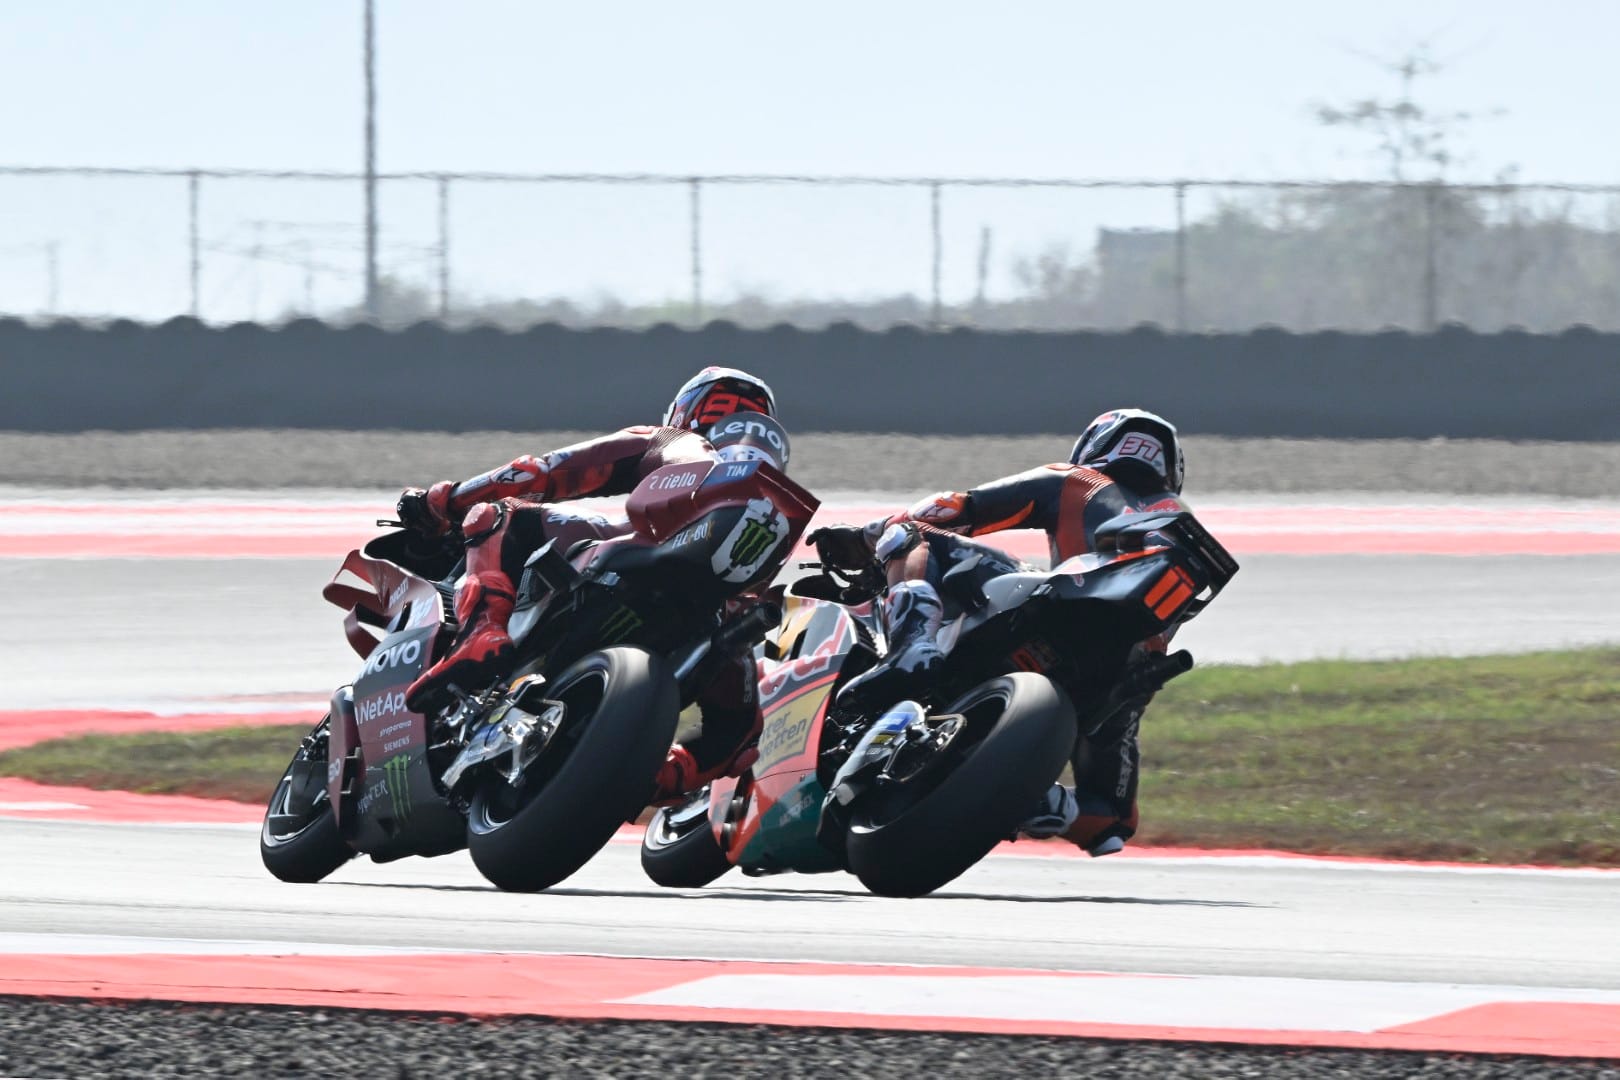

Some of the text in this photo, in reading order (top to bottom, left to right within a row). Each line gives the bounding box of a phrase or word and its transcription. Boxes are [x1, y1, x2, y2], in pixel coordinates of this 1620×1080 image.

[1118, 436, 1161, 461] 37
[725, 465, 749, 477] TIM
[658, 471, 697, 490] riello
[384, 735, 410, 752] SIEMENS
